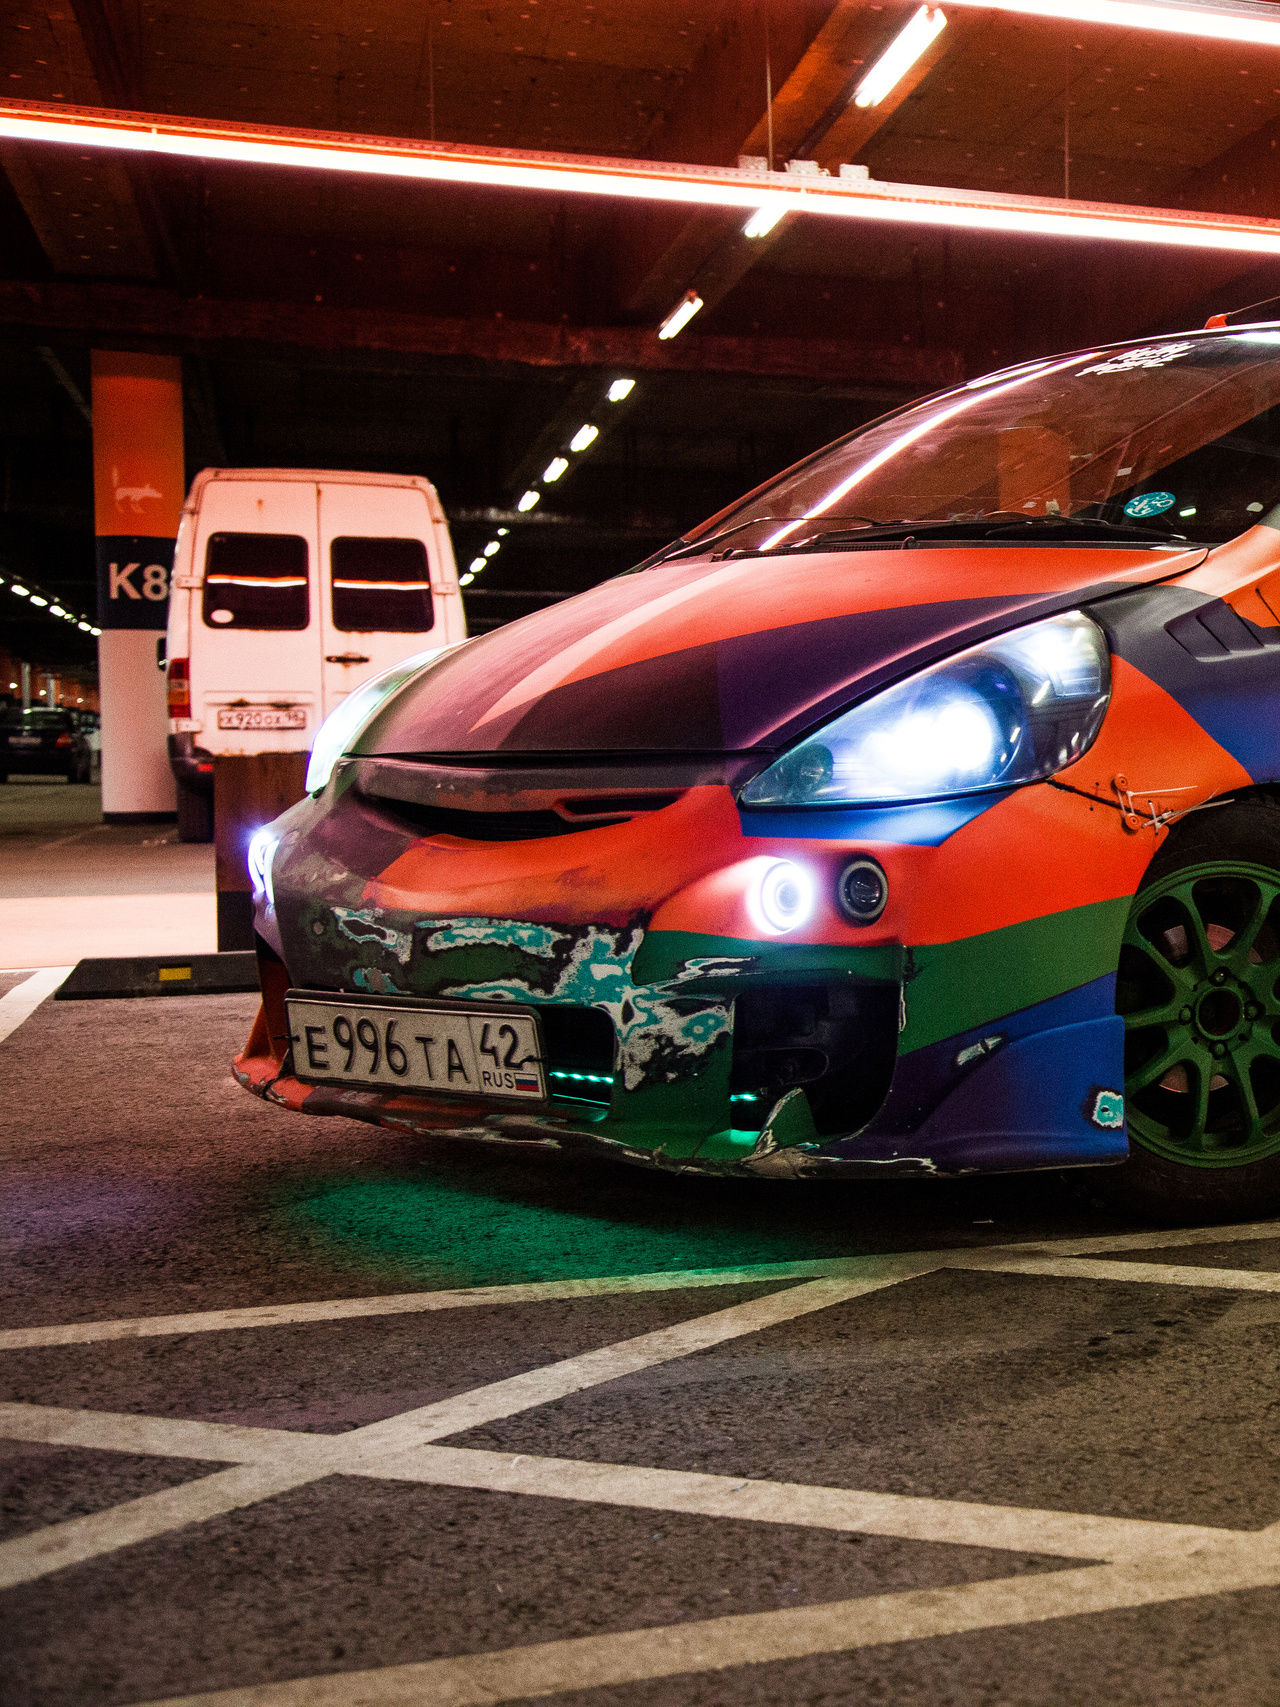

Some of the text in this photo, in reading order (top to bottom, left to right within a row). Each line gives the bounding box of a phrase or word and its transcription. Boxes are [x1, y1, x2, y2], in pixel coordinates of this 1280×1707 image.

[304, 1014, 525, 1084] Е996ТА 42
[482, 1070, 515, 1089] RUS
